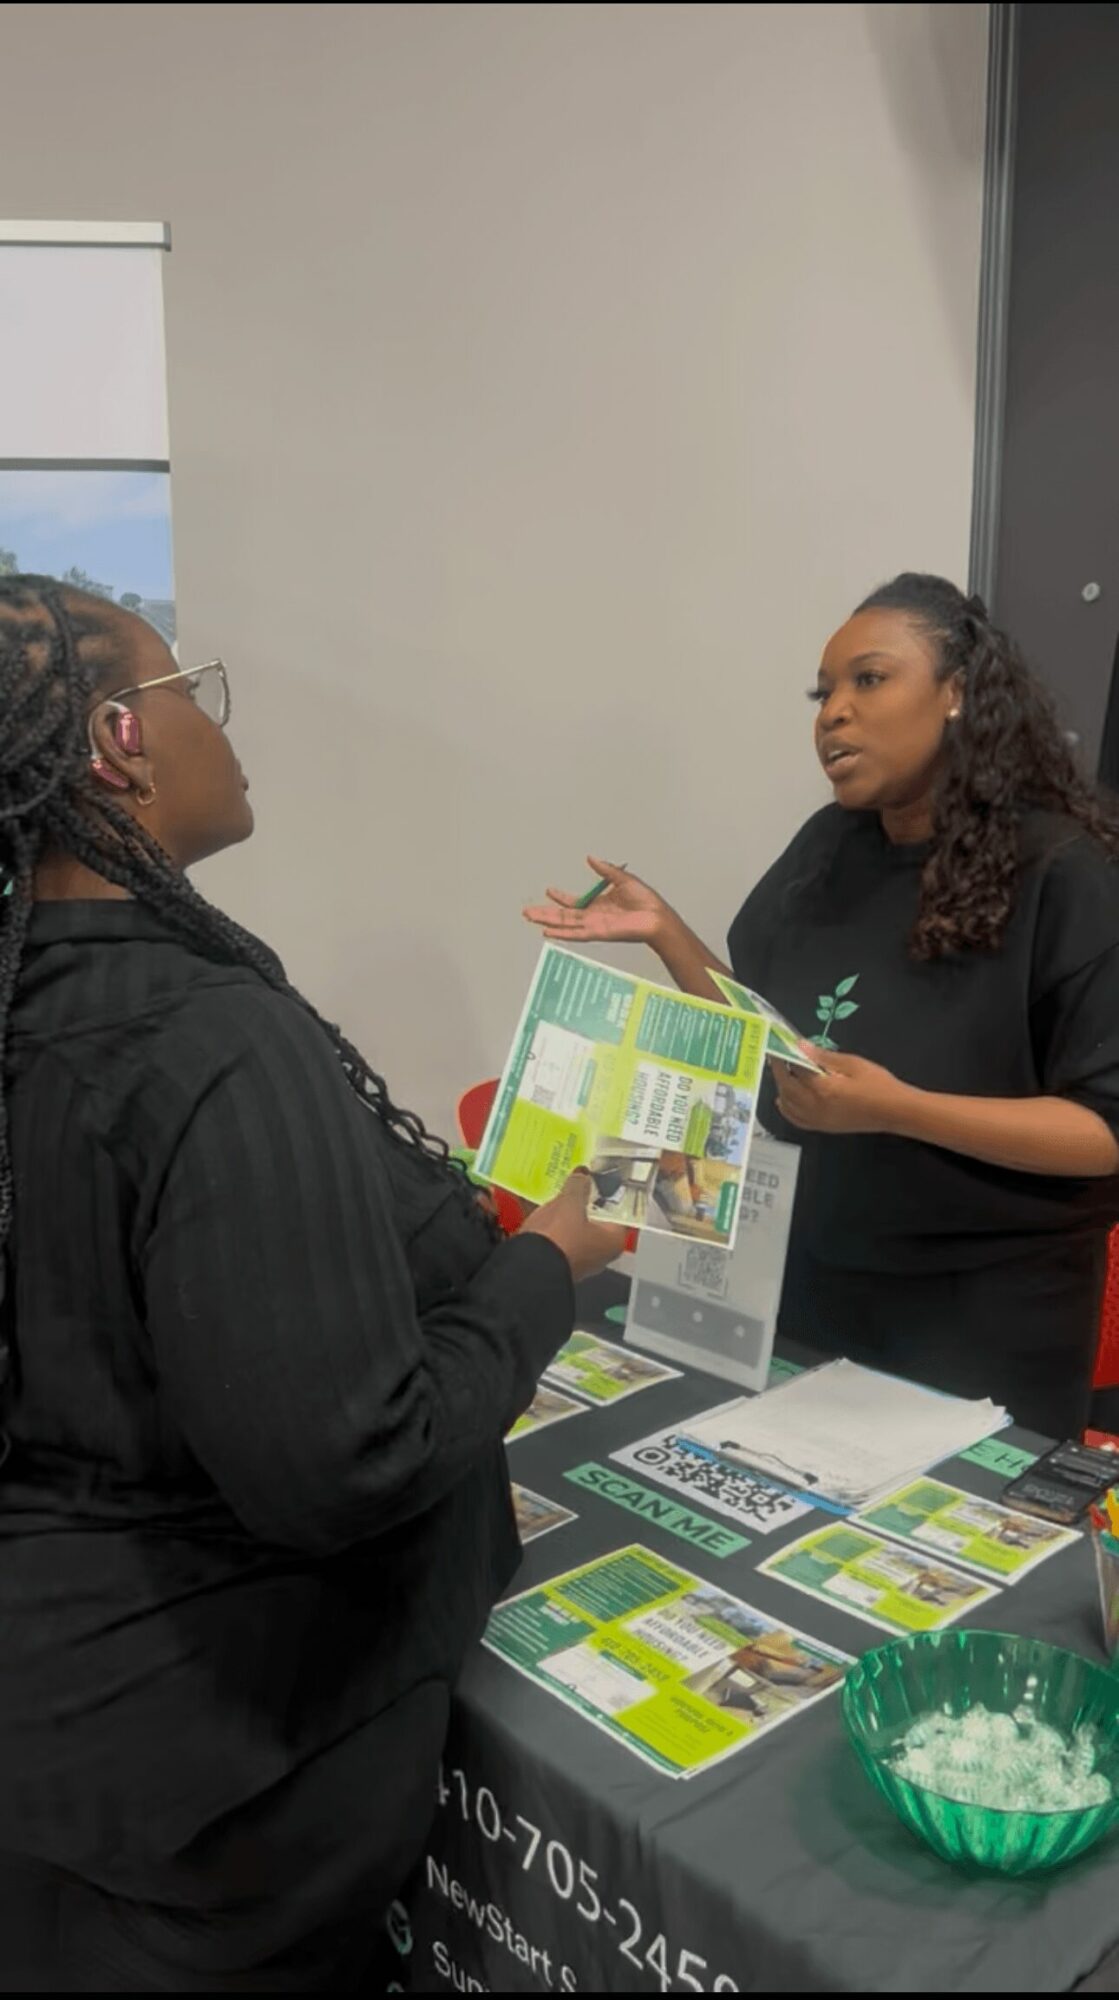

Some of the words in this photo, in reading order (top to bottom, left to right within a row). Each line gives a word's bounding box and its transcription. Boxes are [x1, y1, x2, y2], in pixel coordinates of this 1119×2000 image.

[627, 1072, 650, 1126] HOUSING?
[643, 1071, 672, 1137] AFFORDABLE
[672, 1093, 689, 1115] YOU
[677, 1076, 693, 1092] DO
[666, 1116, 685, 1143] NEED
[579, 1469, 672, 1518] SCAN
[670, 1516, 734, 1550] ME
[642, 1617, 709, 1659] AFFORDABLE
[697, 1631, 726, 1651] NEED
[427, 1855, 553, 1987] NewStart
